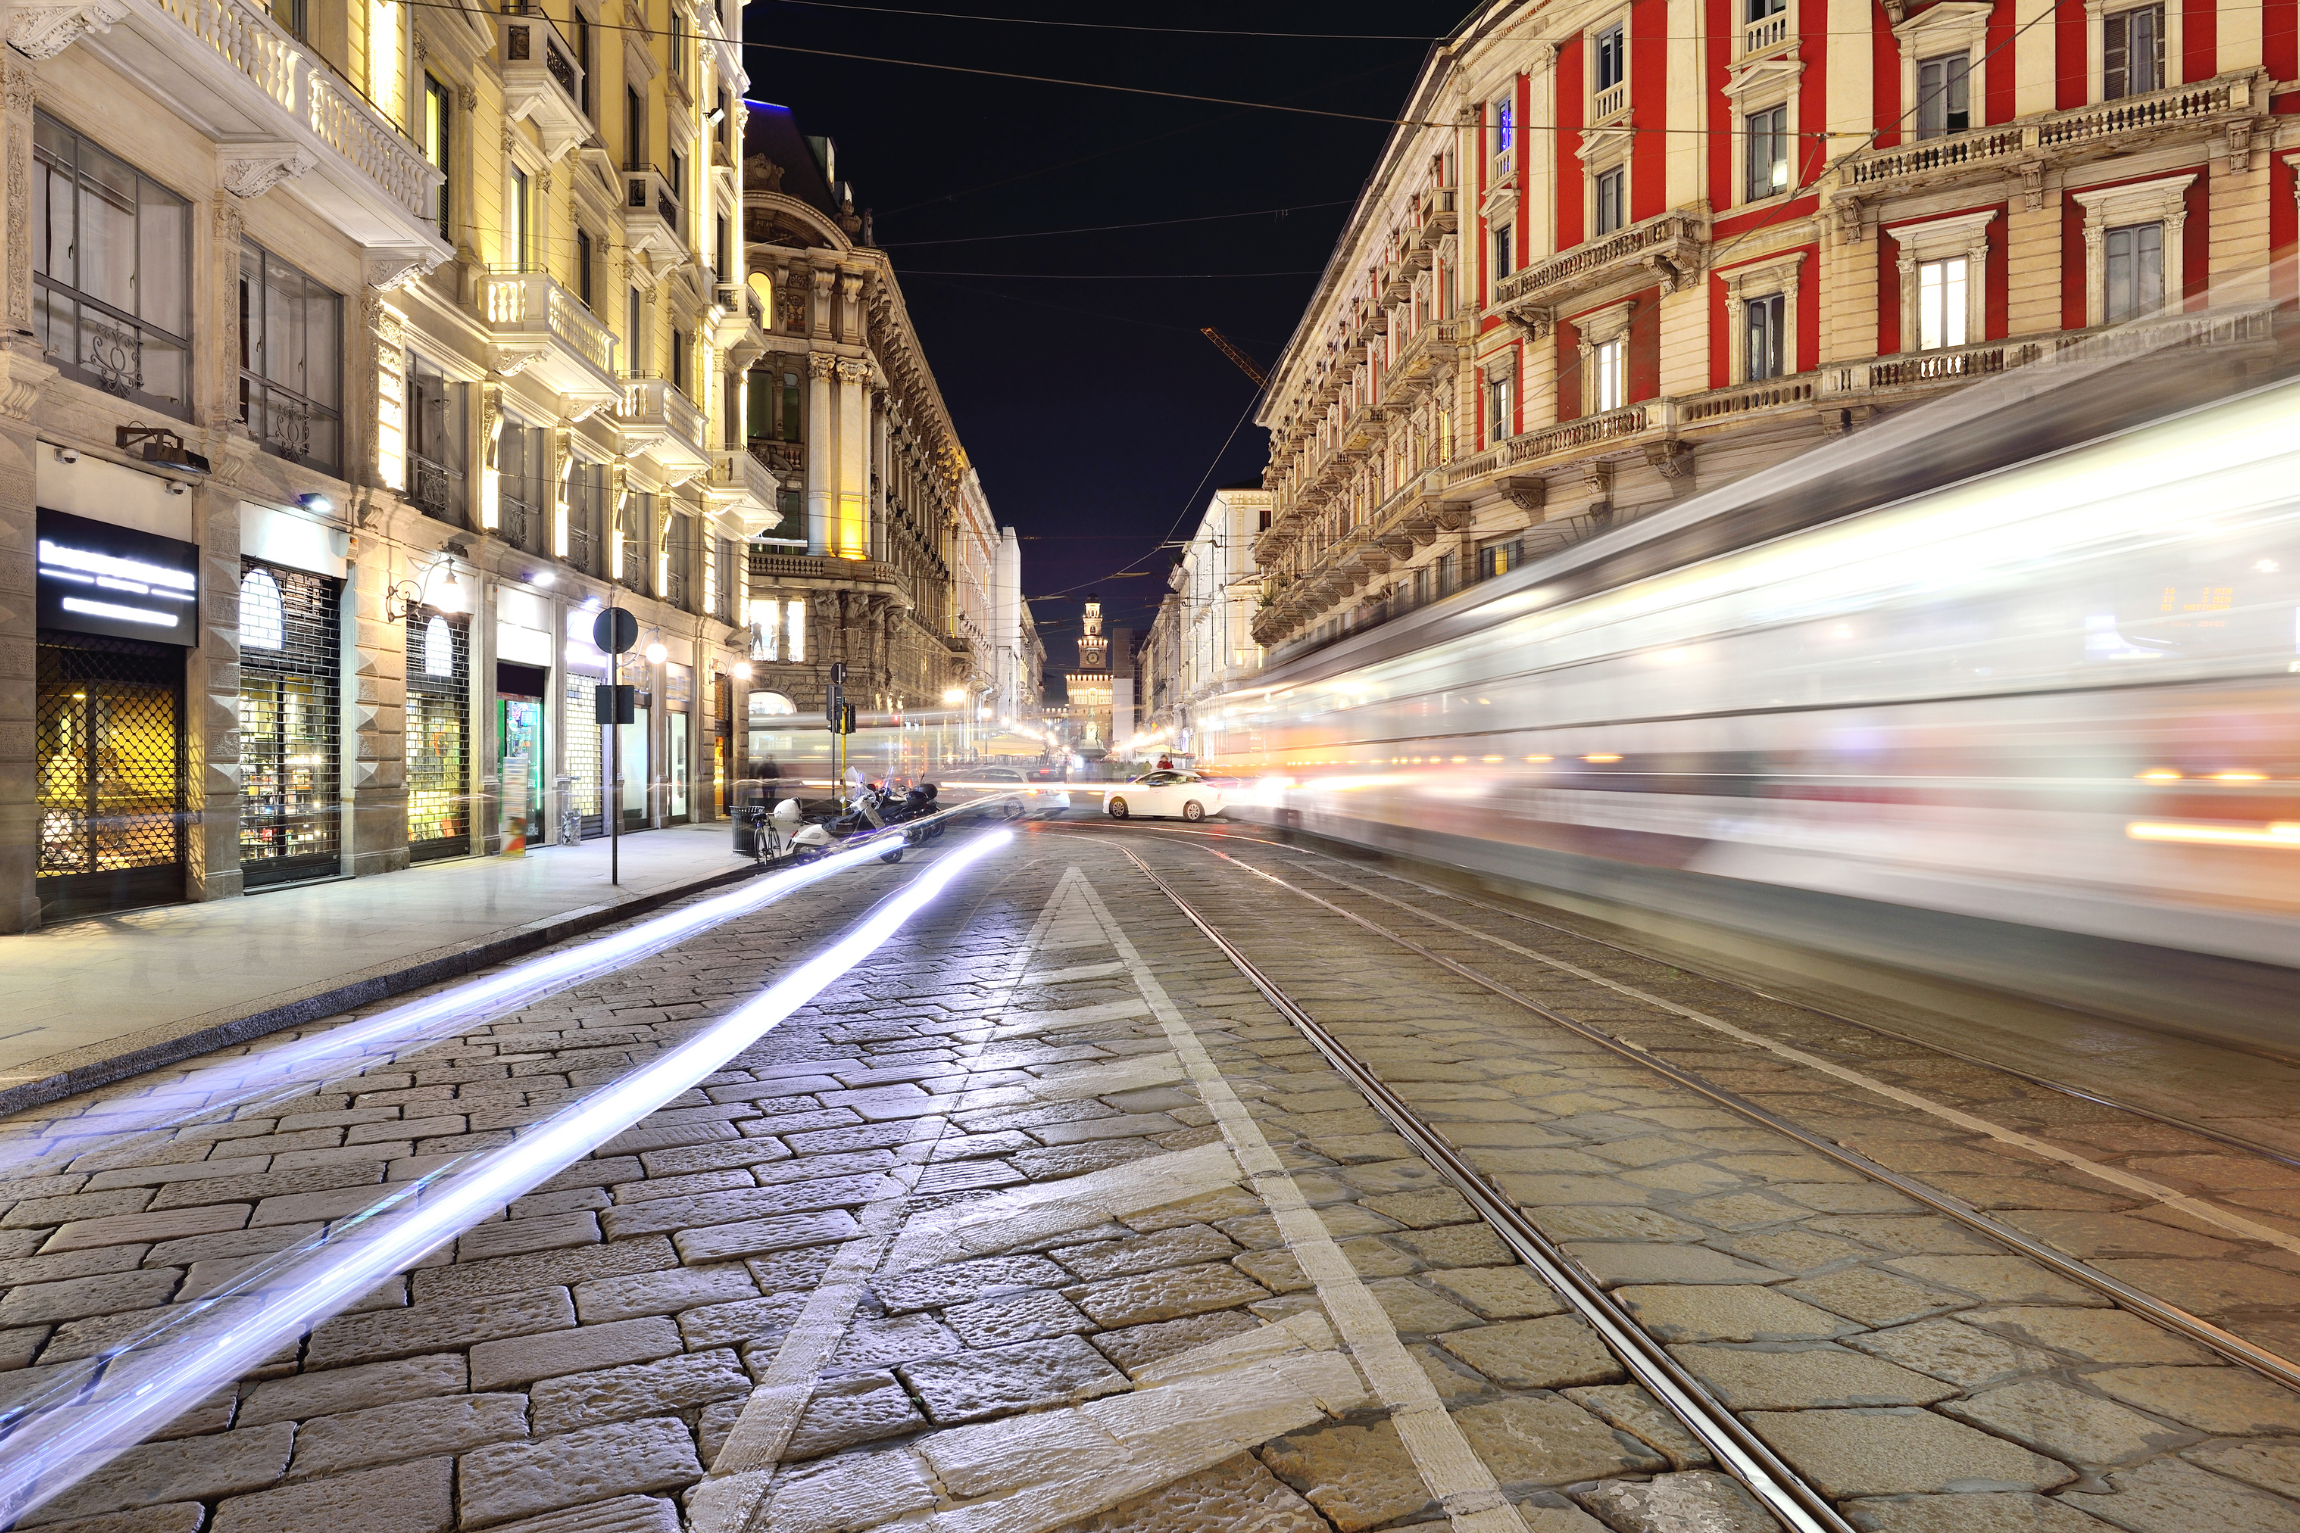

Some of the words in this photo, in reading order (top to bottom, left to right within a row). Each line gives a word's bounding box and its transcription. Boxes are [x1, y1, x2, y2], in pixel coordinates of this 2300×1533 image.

[2163, 587, 2176, 595] 16
[2213, 587, 2233, 595] MIN
[2162, 595, 2175, 603] 19
